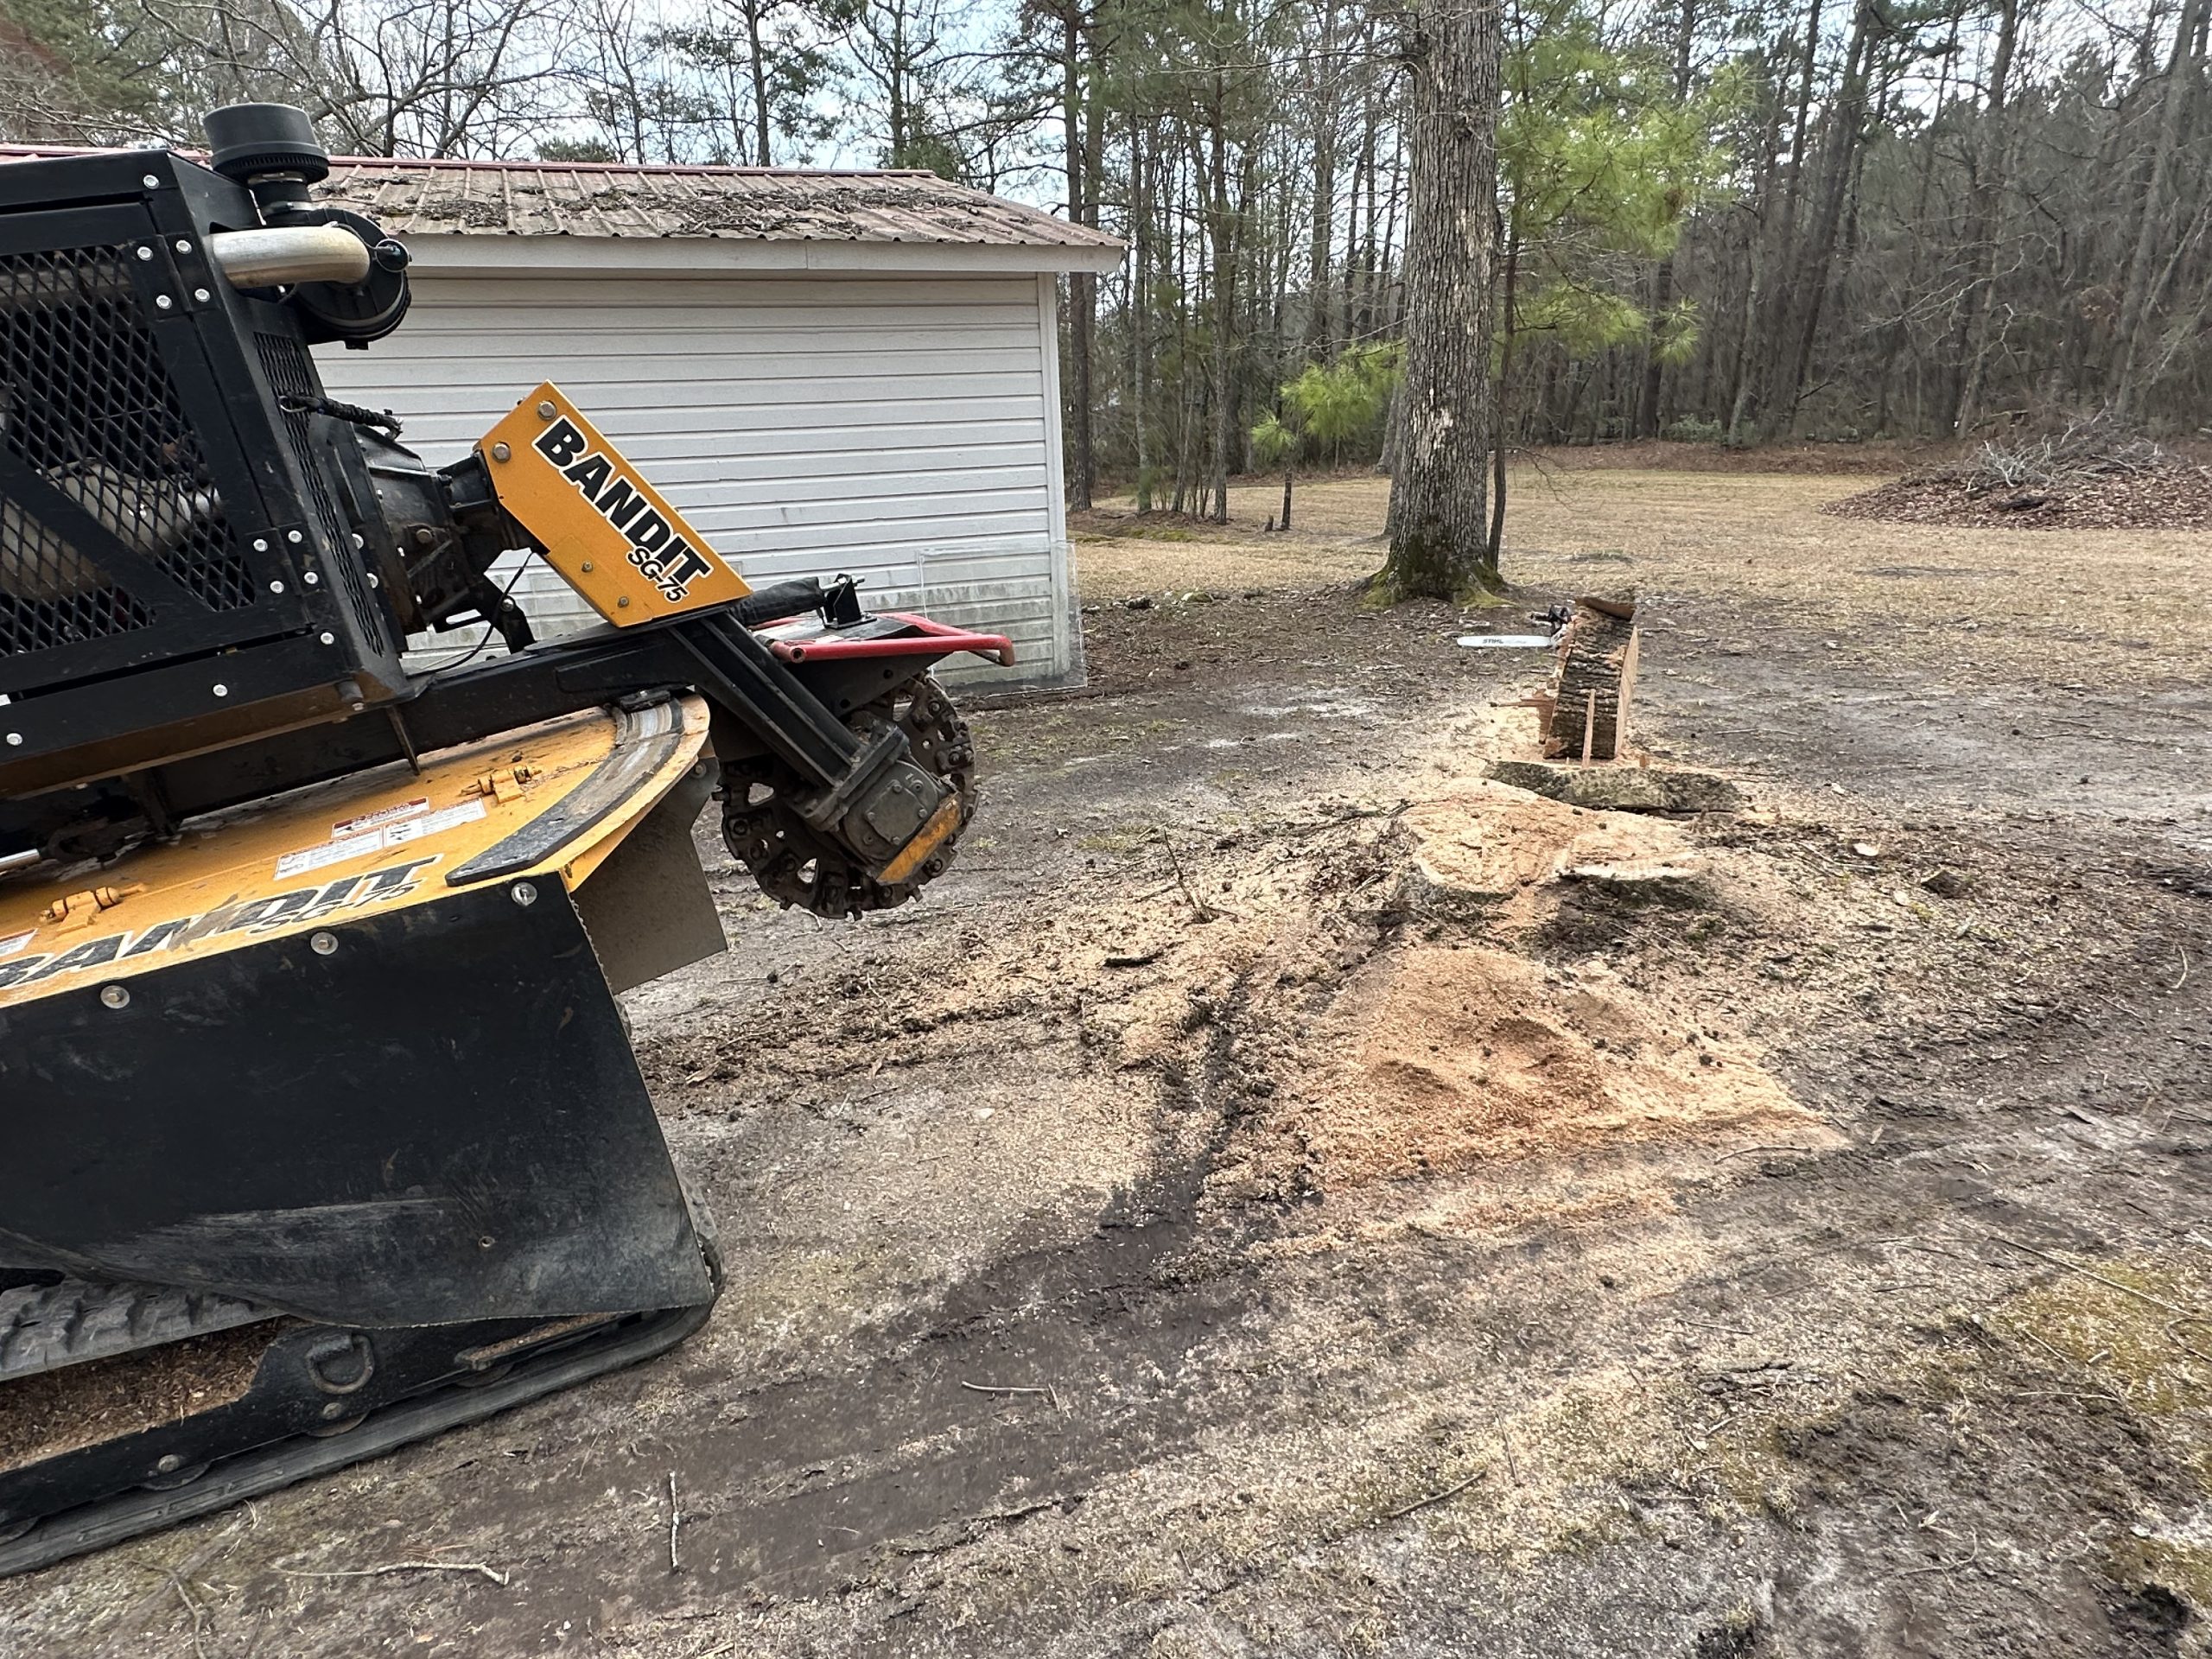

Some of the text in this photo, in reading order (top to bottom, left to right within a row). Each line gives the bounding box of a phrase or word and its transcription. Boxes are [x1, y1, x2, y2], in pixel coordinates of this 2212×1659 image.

[534, 417, 712, 585] BANDIT
[627, 547, 689, 601] SG-75
[249, 879, 426, 934] SG-75
